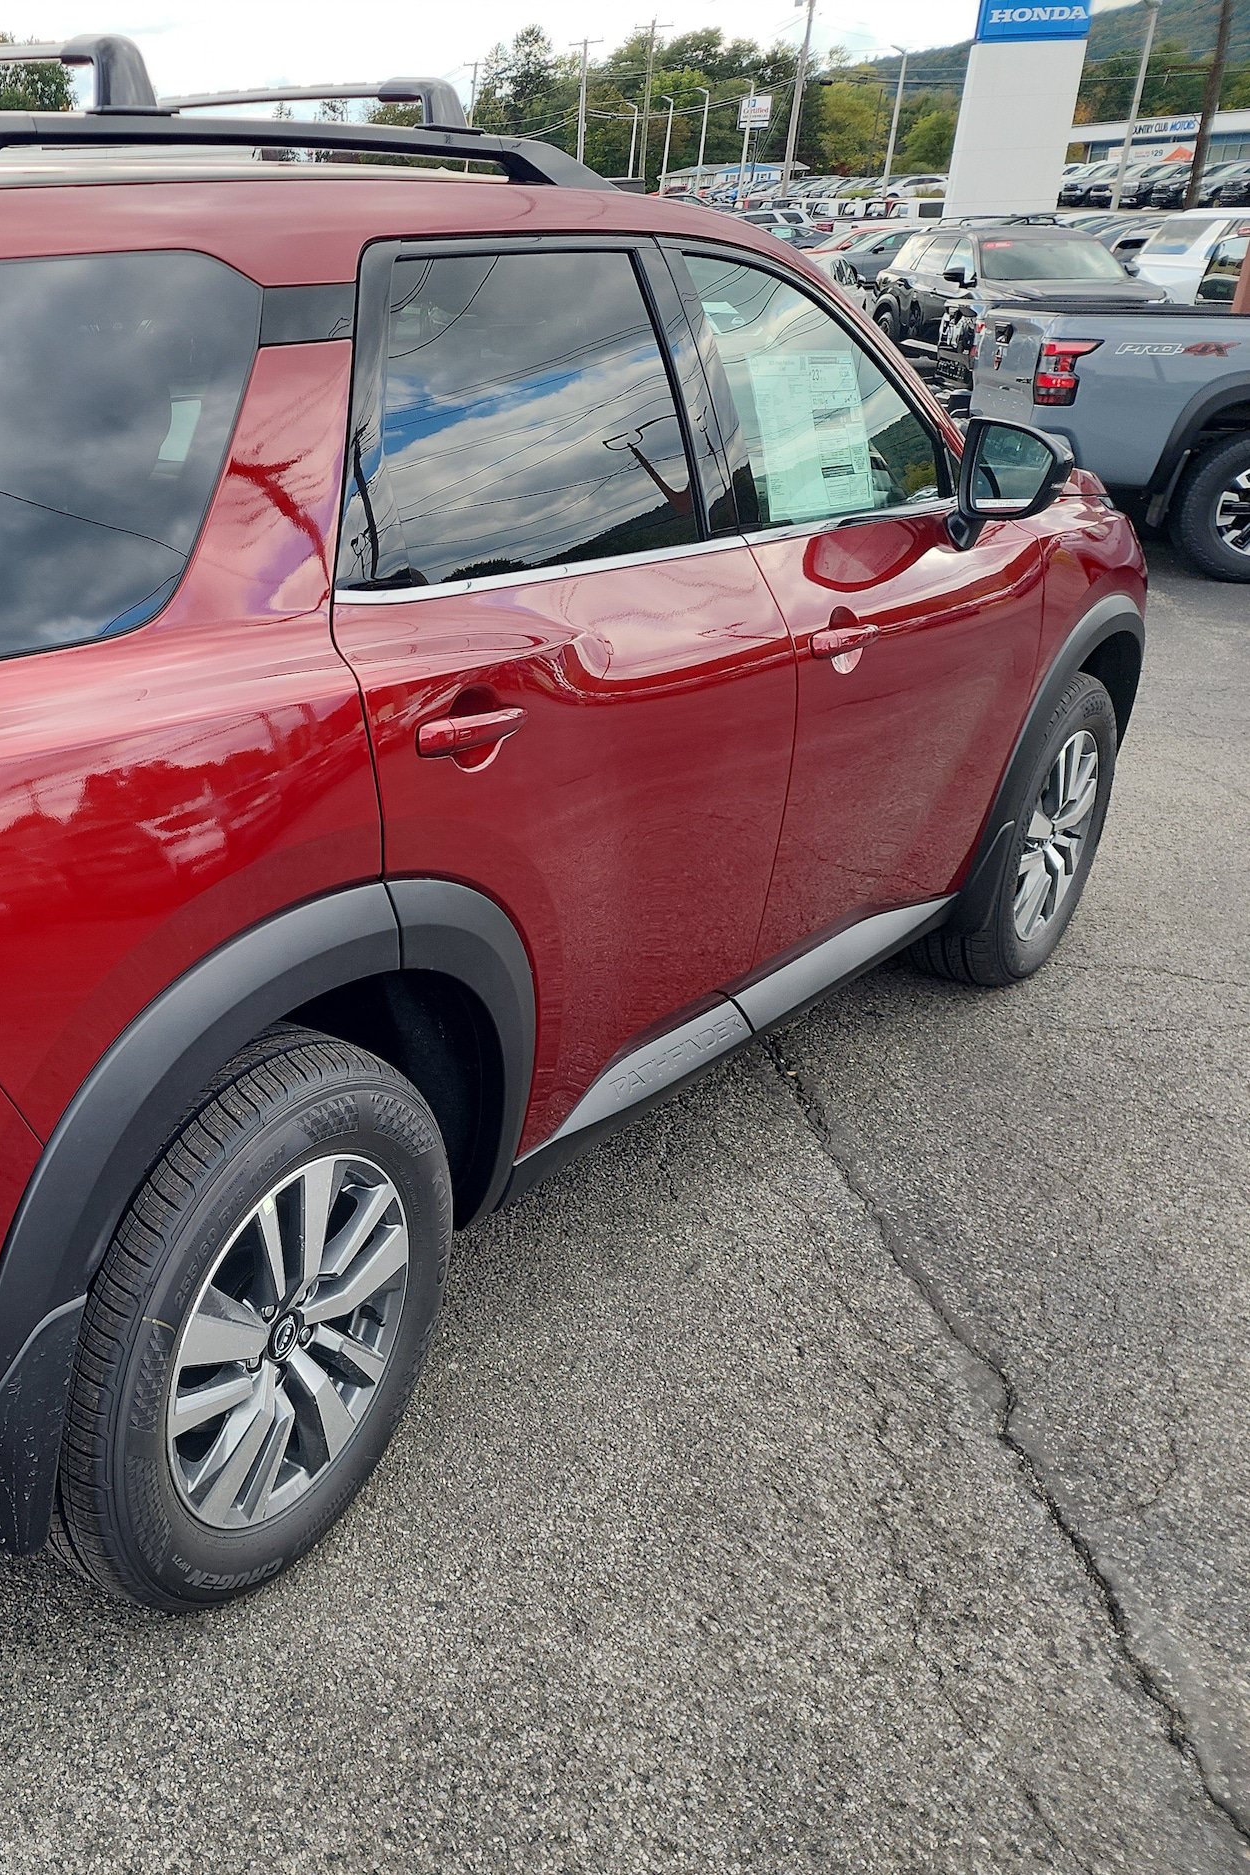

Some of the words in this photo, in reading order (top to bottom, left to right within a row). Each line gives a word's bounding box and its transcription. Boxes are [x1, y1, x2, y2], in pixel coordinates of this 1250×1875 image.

[989, 6, 1088, 24] HONDA
[1154, 122, 1169, 133] CLUB
[1169, 119, 1196, 131] MOTORS
[608, 1013, 745, 1102] PATHFINDER
[183, 1557, 284, 1591] CRUGEN
